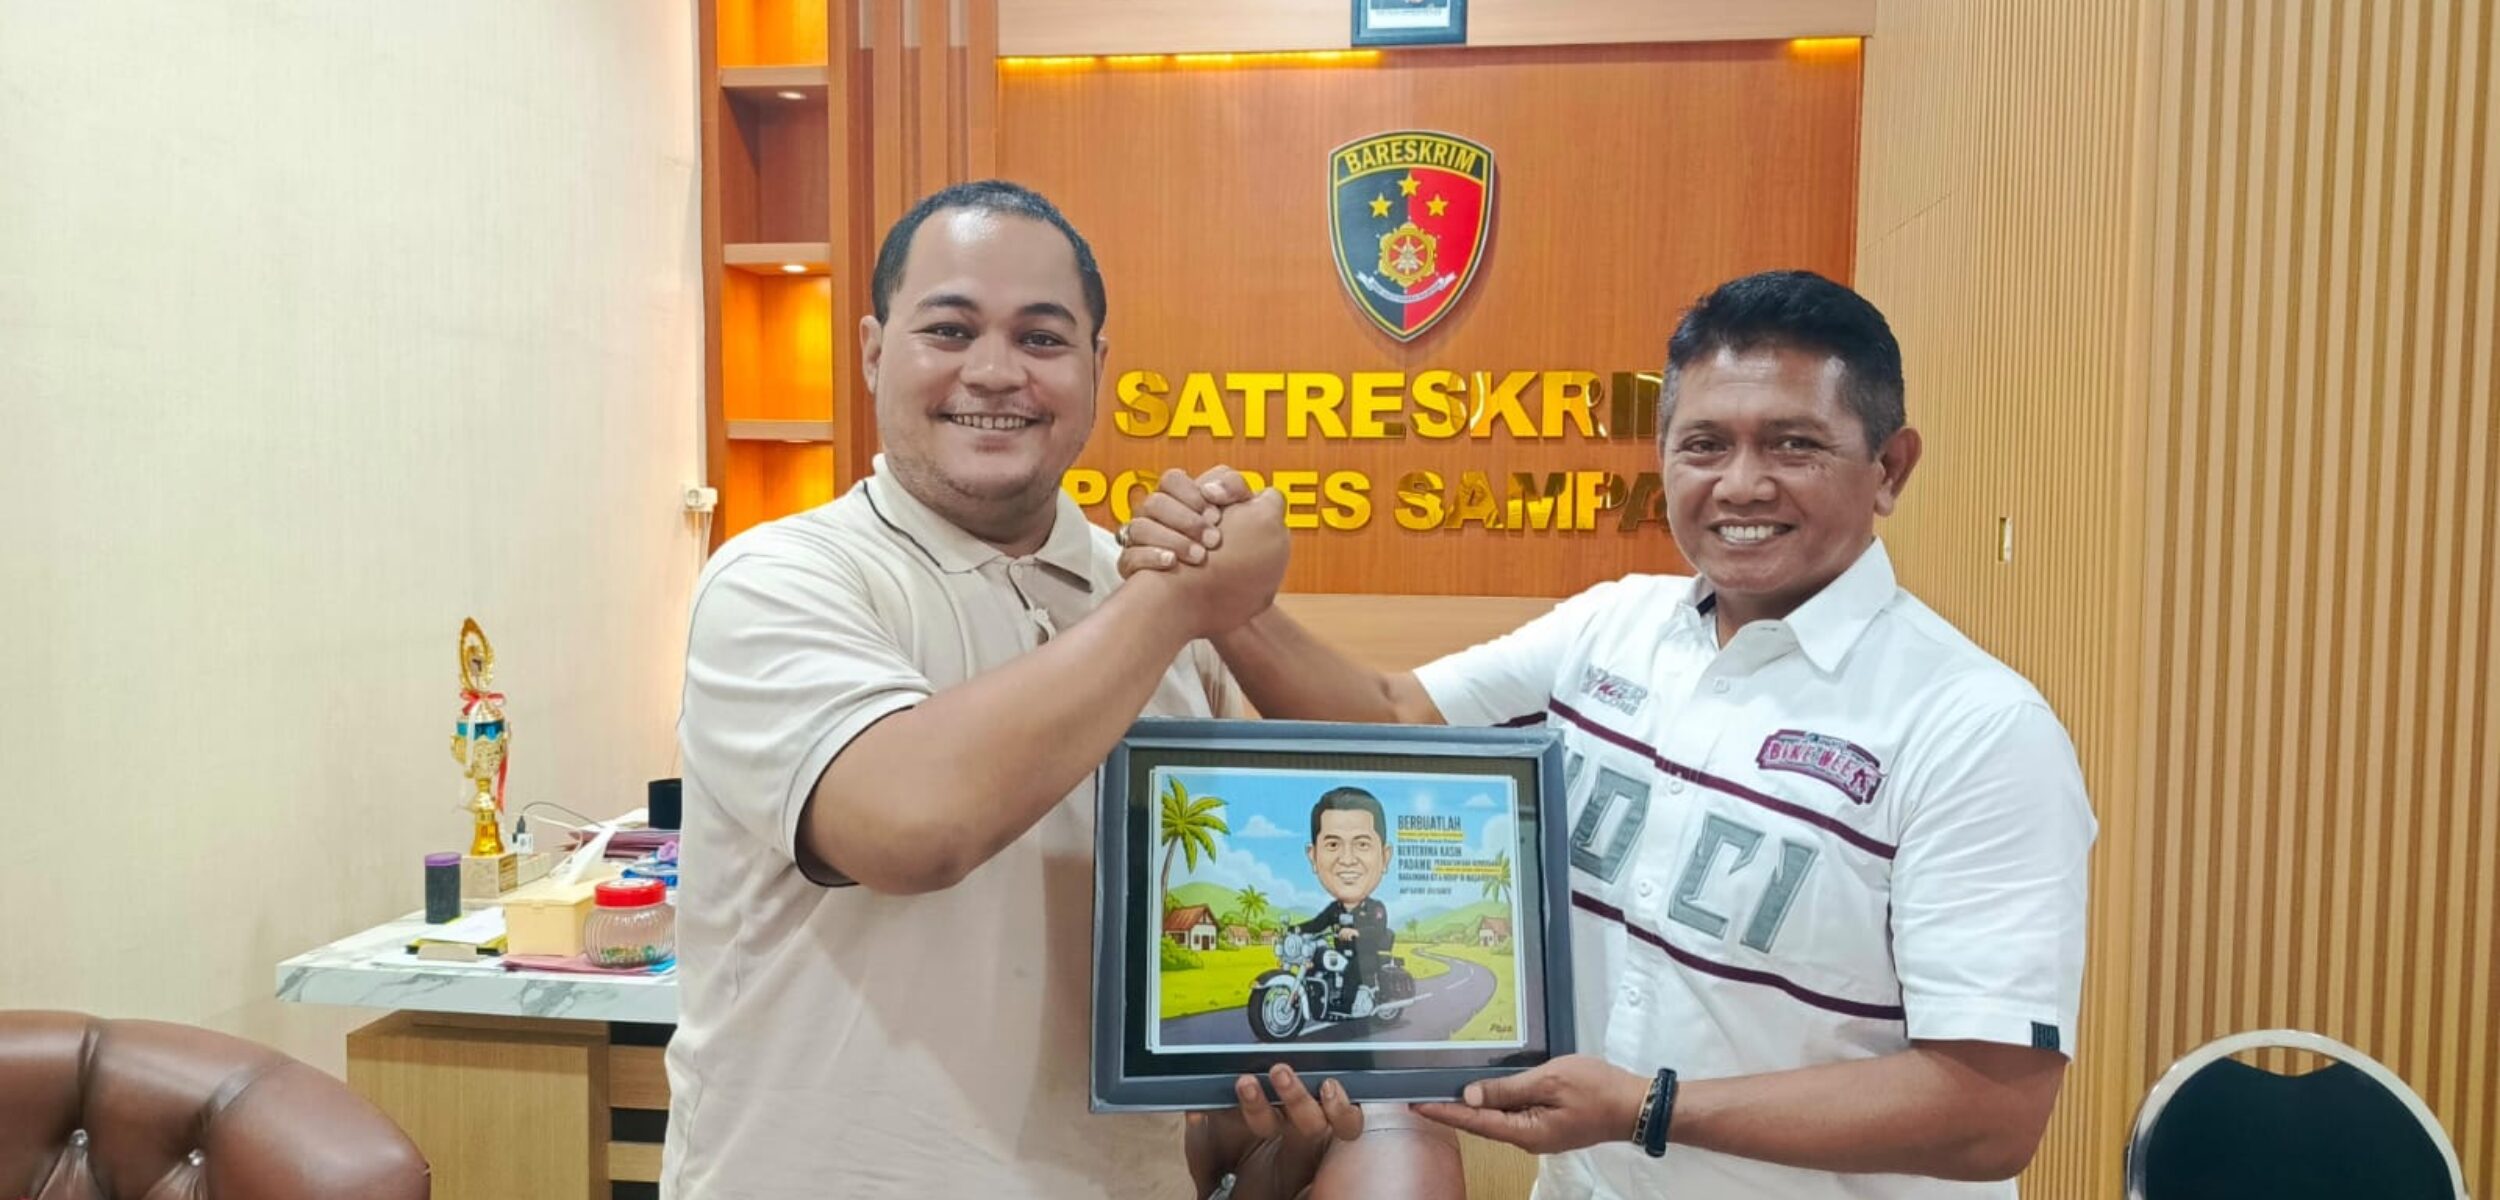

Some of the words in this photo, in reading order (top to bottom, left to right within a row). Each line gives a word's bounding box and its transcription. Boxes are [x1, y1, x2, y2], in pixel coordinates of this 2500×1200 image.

[1344, 139, 1478, 175] BARESKRIM
[1767, 739, 1816, 765] BIKE
[1397, 815, 1462, 831] BERBUATLAH
